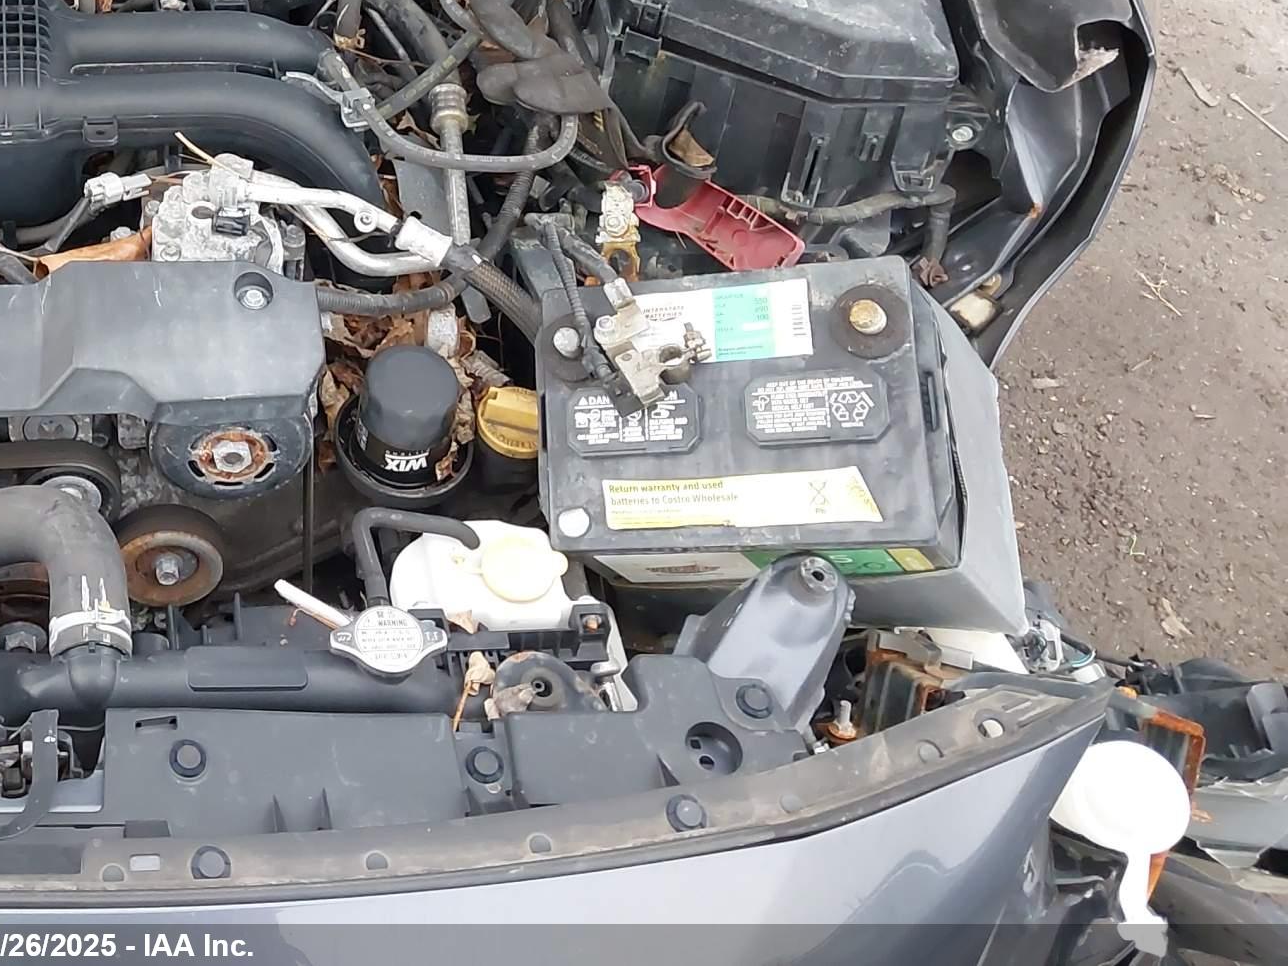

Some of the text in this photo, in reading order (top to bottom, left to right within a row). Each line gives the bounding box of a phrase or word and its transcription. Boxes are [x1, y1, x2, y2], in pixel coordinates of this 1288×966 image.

[384, 456, 428, 472] WIX
[609, 480, 724, 493] Return warranty and used
[611, 496, 649, 506] batteries
[651, 496, 660, 505] to
[692, 492, 739, 503] Wholesale
